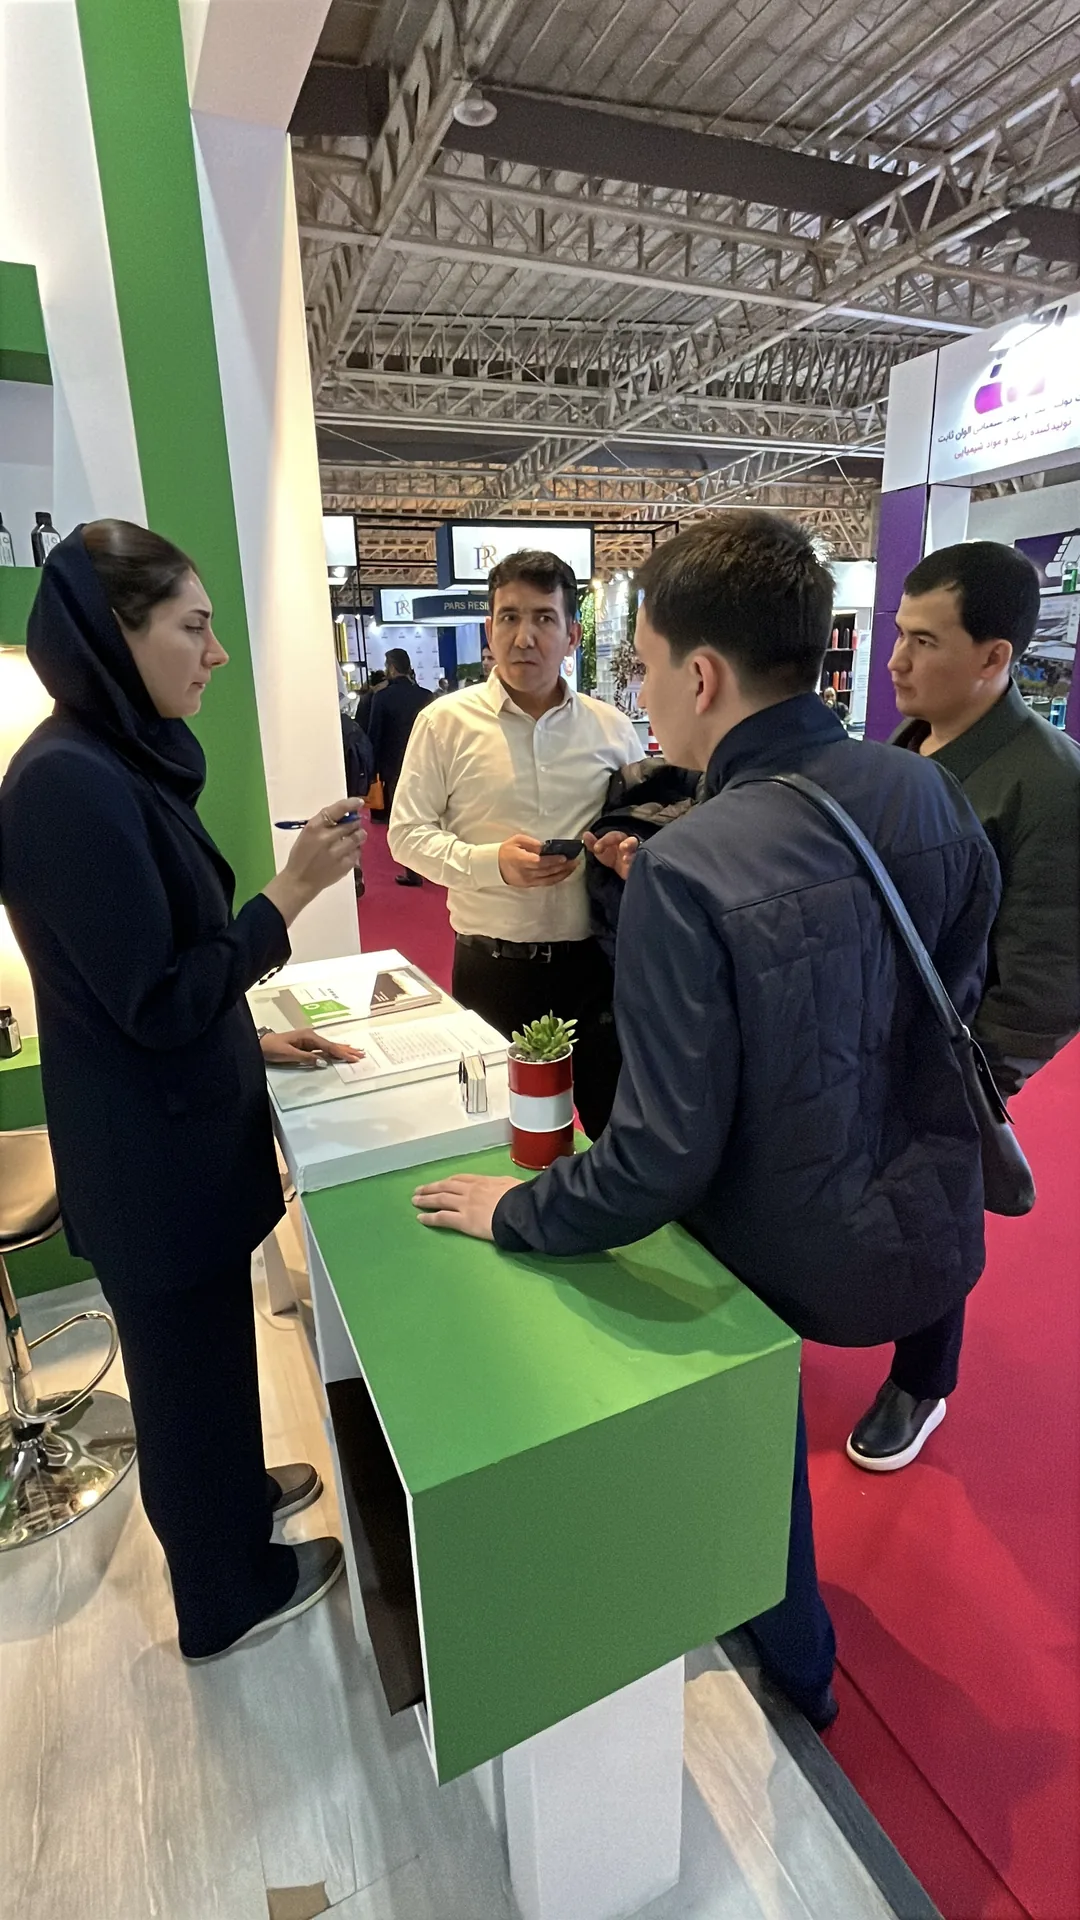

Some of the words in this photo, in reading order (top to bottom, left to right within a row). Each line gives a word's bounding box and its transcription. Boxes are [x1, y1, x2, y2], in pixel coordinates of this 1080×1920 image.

[937, 429, 955, 443] ثابت
[955, 425, 972, 441] الوان
[954, 441, 984, 460] شیمیایی
[986, 439, 1001, 450] مواد
[443, 601, 466, 611] PARS
